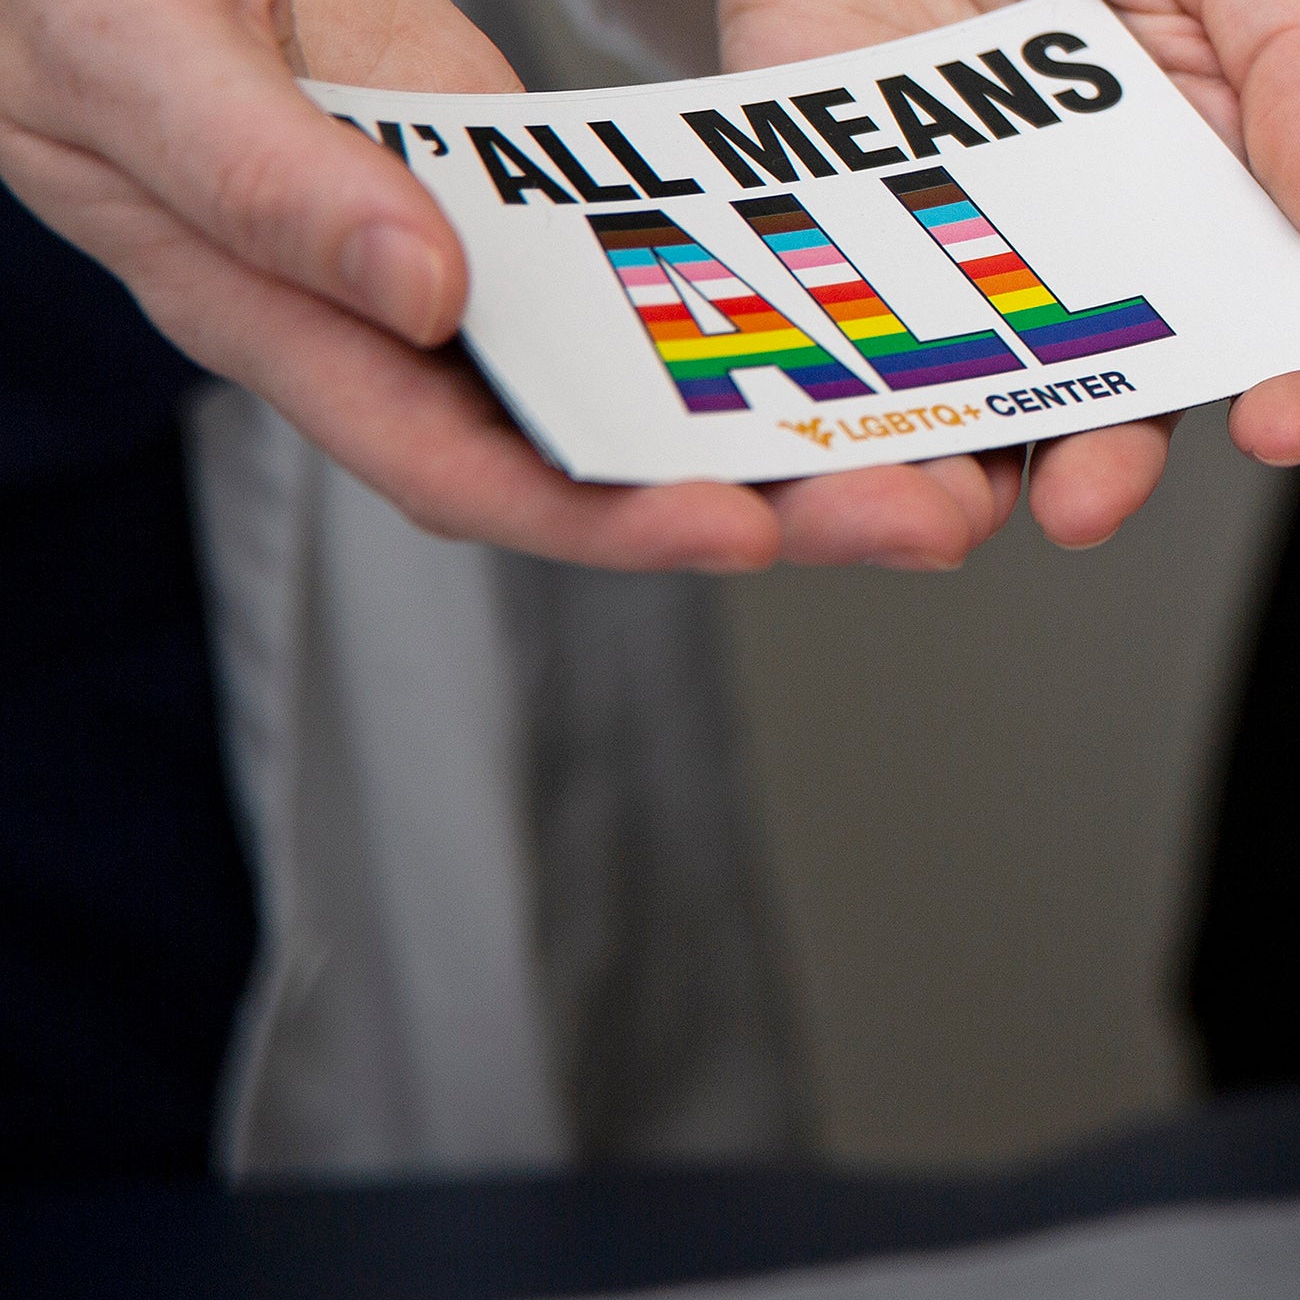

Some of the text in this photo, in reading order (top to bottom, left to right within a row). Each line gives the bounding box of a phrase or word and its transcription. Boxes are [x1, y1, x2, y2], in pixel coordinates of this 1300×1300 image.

[680, 31, 1123, 190] MEANS
[585, 166, 1177, 414] ALL
[839, 403, 981, 443] LGBTQ+
[985, 370, 1137, 418] CENTER
